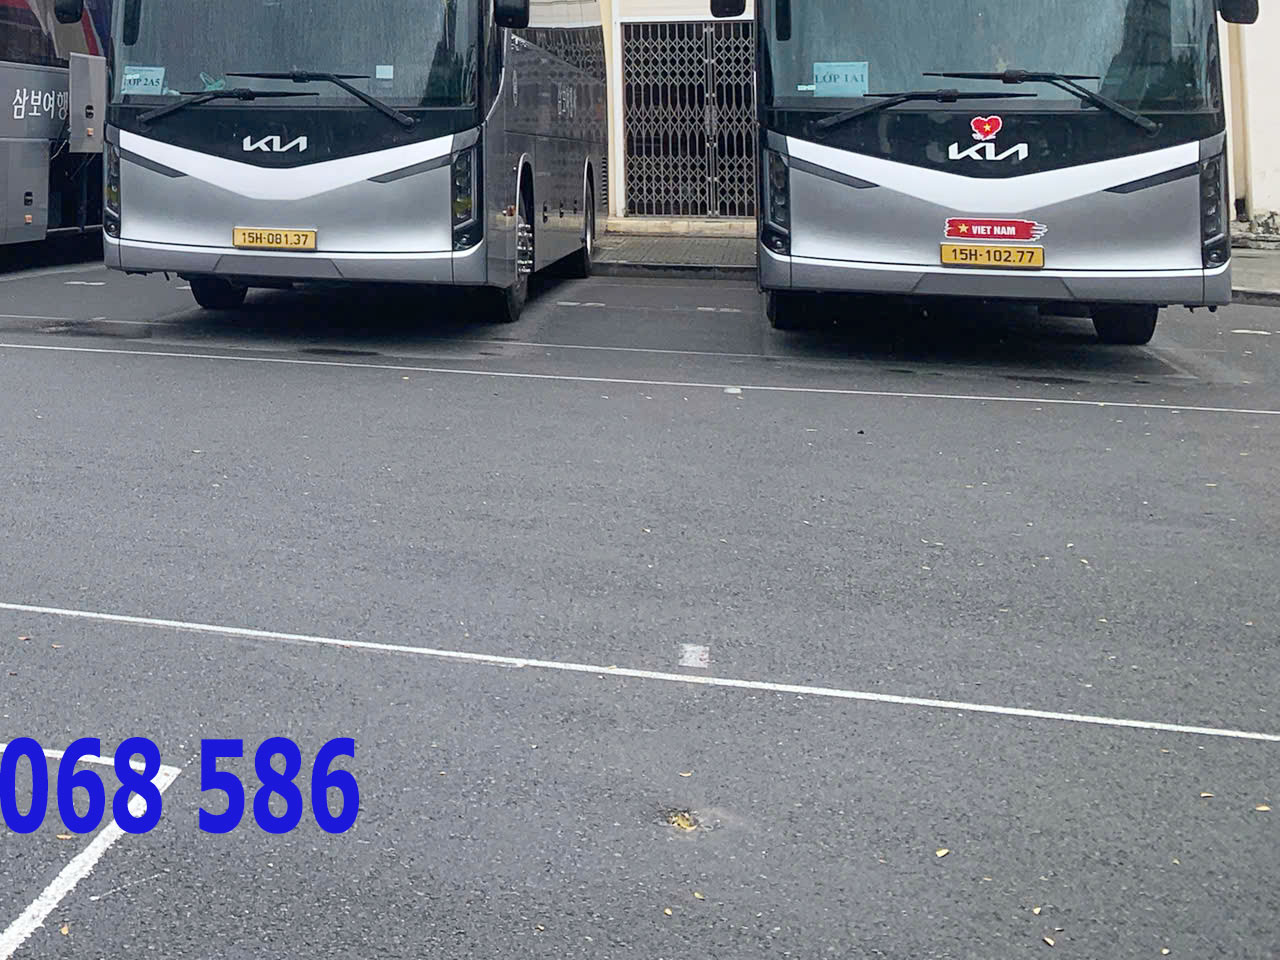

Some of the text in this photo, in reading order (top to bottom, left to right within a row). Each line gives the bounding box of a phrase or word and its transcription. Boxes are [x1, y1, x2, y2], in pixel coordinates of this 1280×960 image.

[12, 87, 69, 120] 삼보여행
[243, 135, 308, 152] KIA
[948, 142, 1029, 161] KIA
[971, 225, 1016, 236] VIET NAM
[241, 232, 309, 246] 15H-081.37
[951, 248, 1035, 263] 15H-102.77
